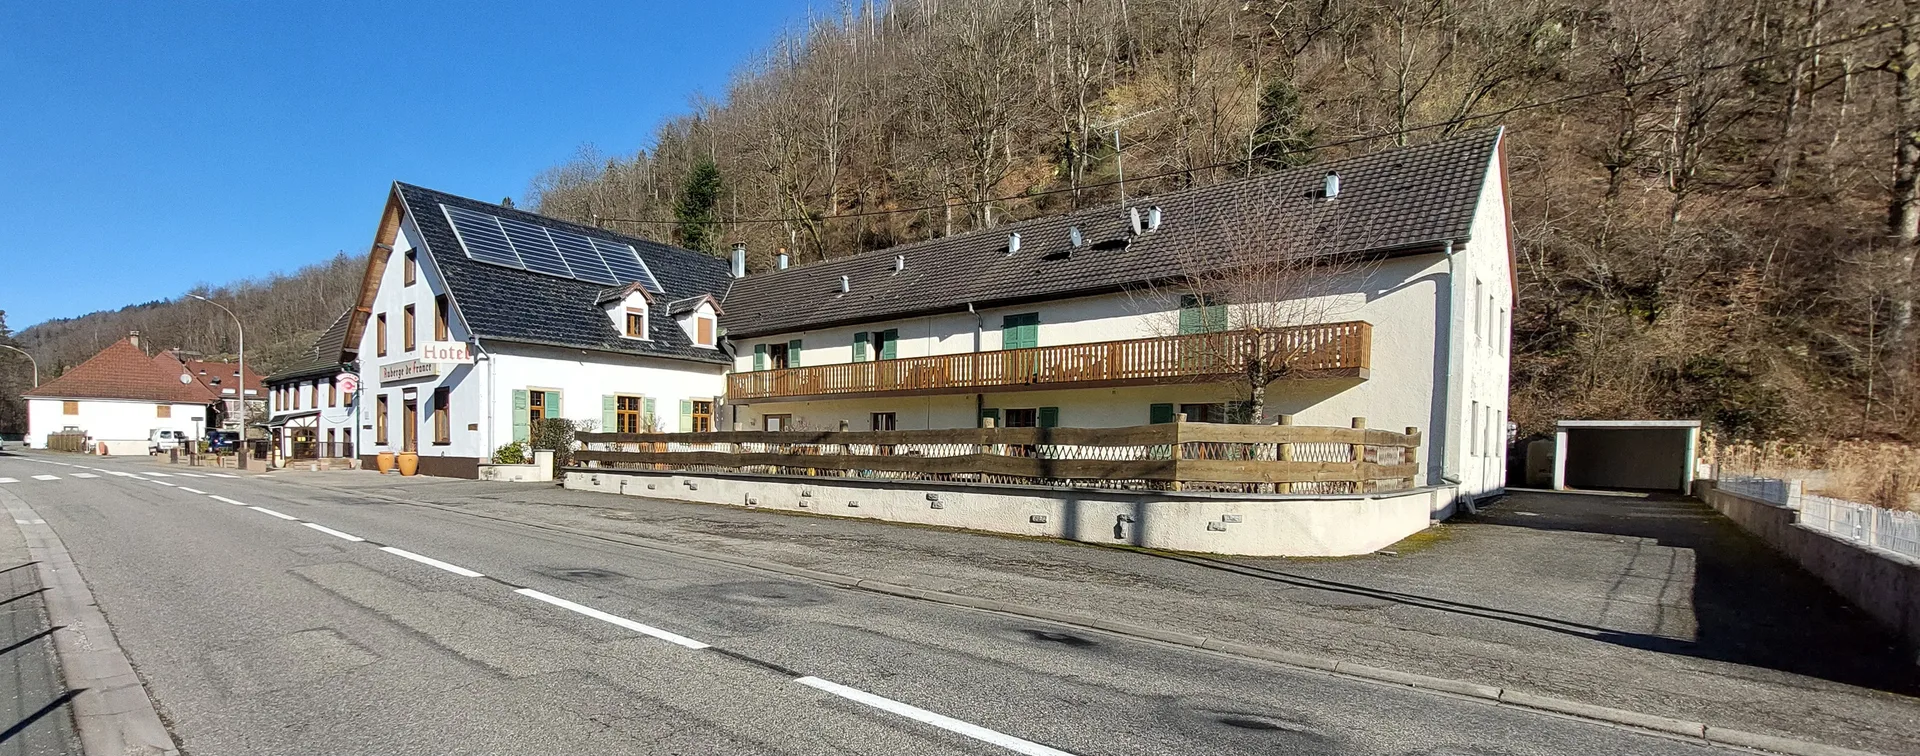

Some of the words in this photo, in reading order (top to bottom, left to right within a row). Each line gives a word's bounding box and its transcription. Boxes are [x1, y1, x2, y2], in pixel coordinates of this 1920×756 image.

[424, 343, 471, 360] Hotel
[383, 367, 404, 379] Auberge
[405, 364, 412, 375] de
[412, 360, 432, 374] France
